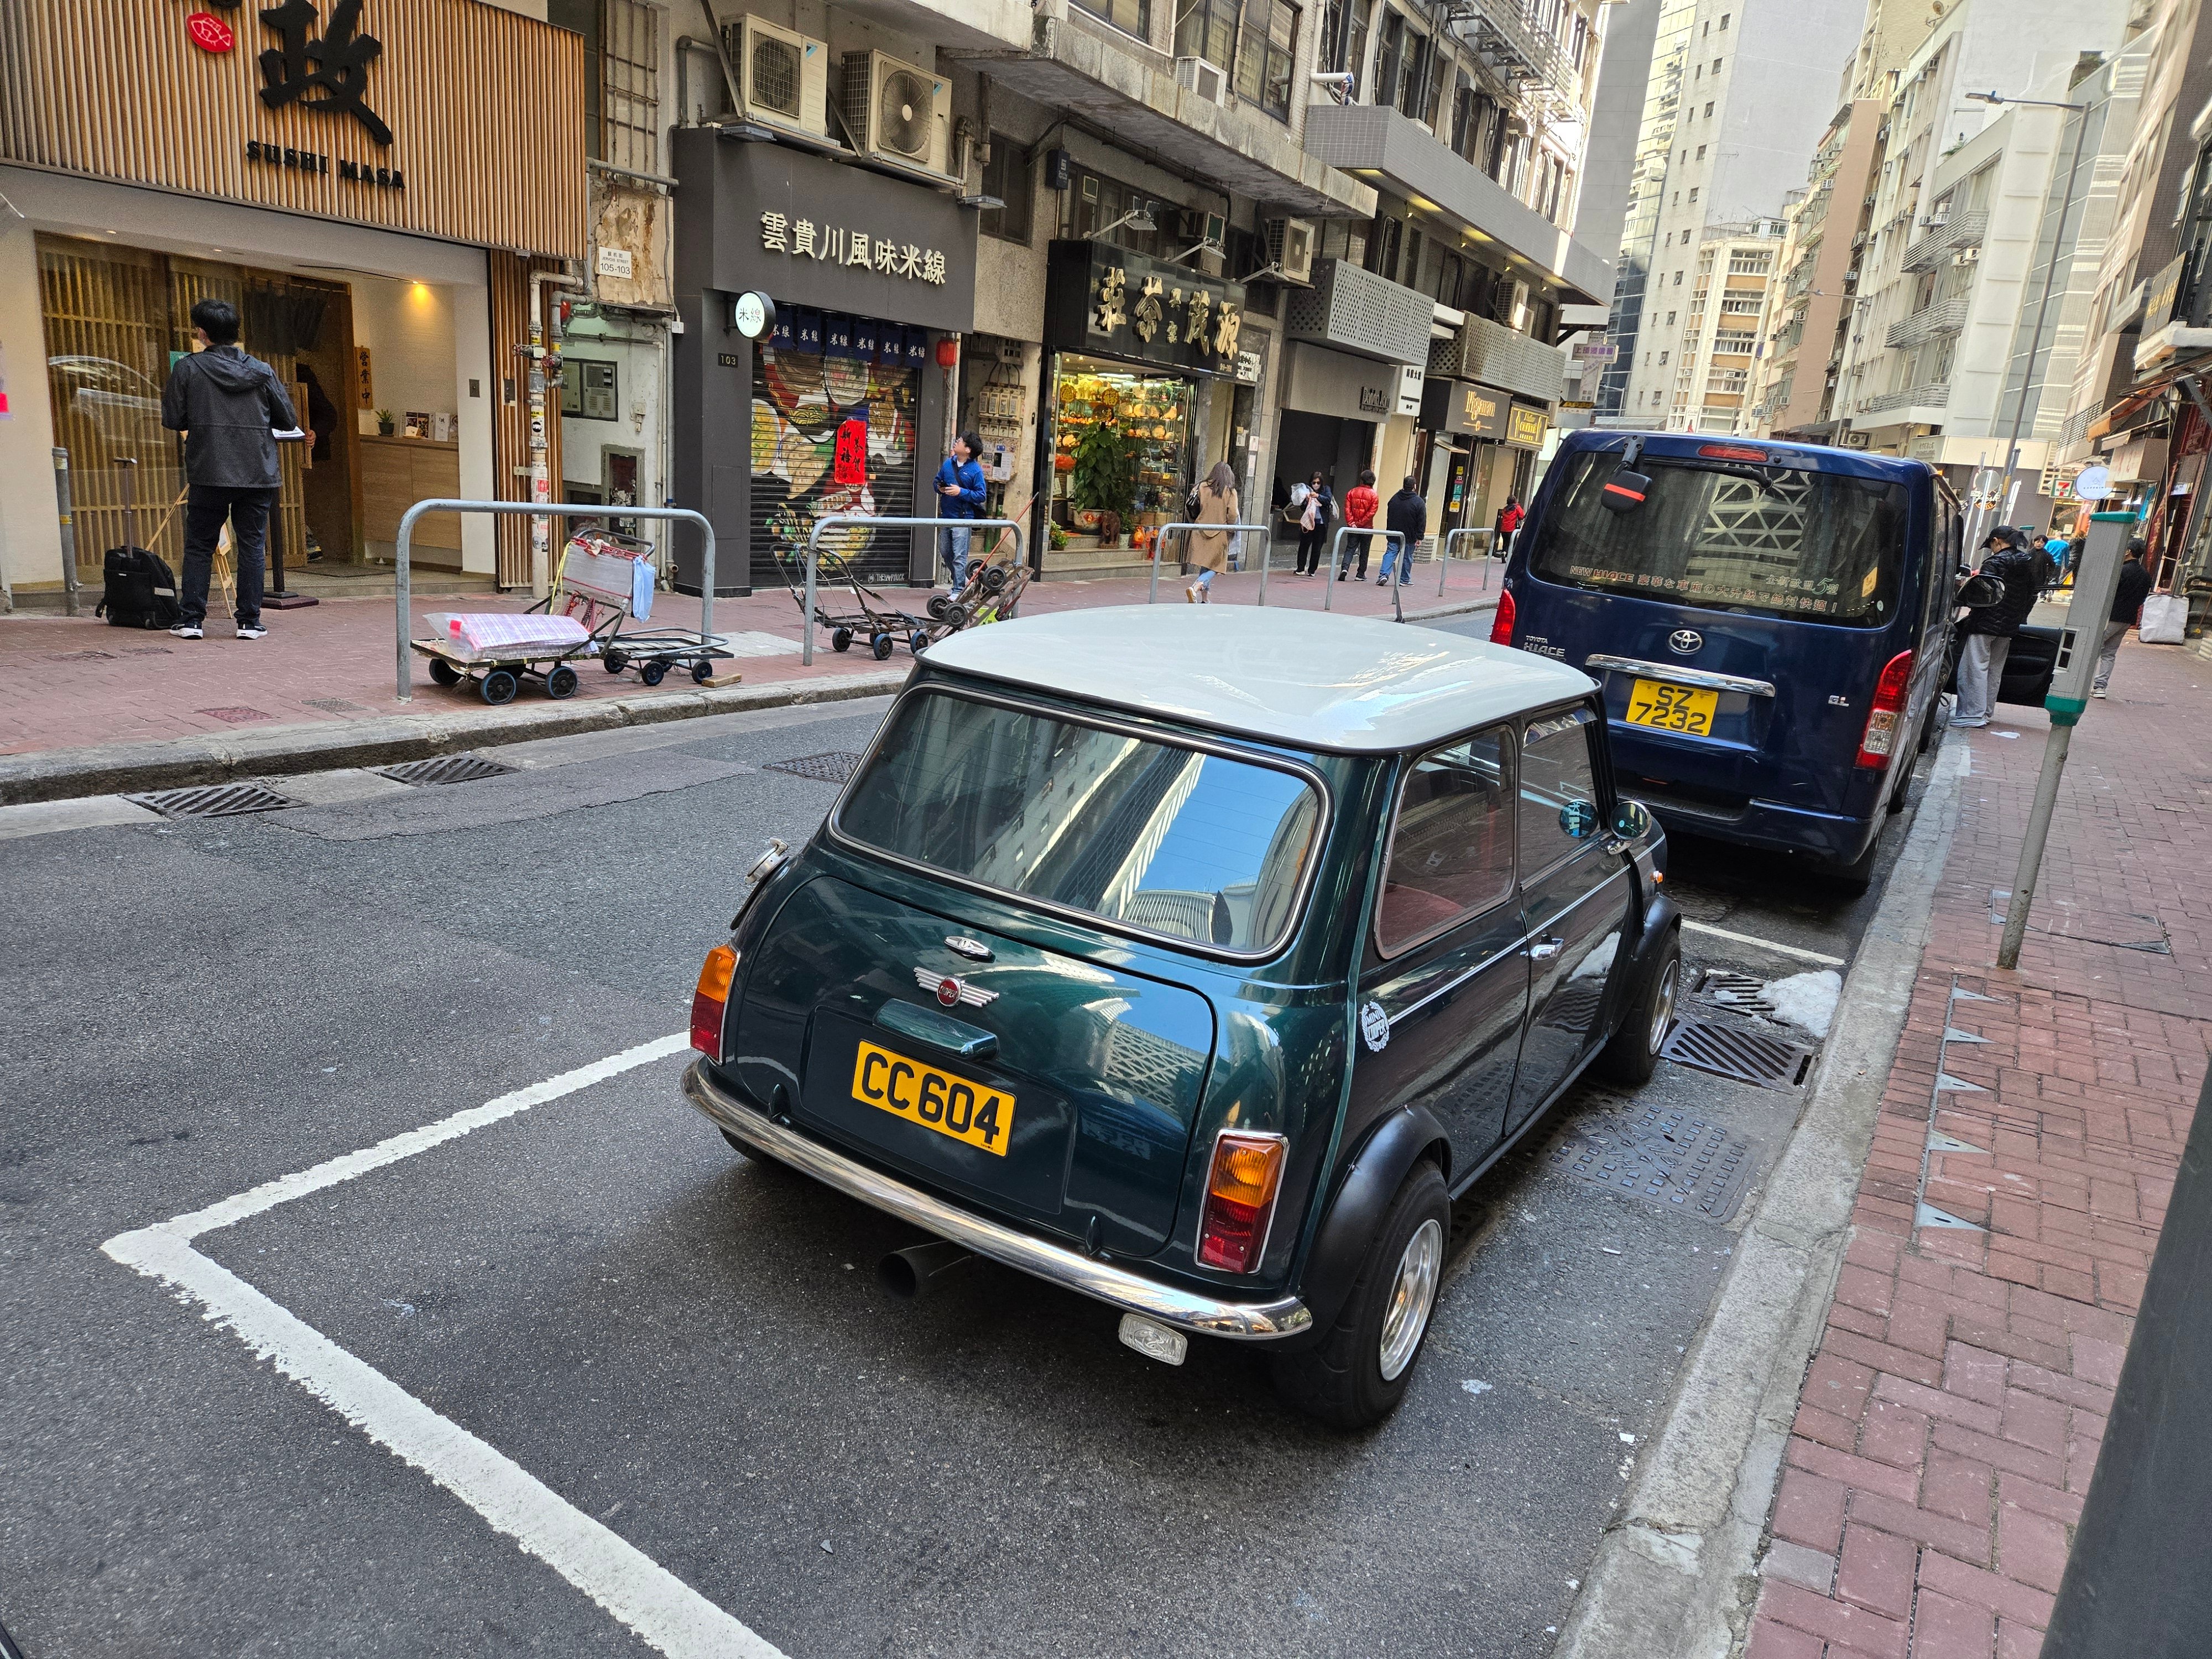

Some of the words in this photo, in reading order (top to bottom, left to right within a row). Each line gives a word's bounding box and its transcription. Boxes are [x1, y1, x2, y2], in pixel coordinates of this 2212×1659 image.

[247, 139, 329, 174] SUSHI
[340, 159, 405, 189] MASA
[760, 211, 946, 284] 雲貴川風味米線
[601, 263, 630, 274] 105-103
[739, 307, 761, 322] 米線
[800, 328, 818, 342] 米線
[830, 333, 848, 346] 米線
[857, 337, 874, 351] 米線
[884, 341, 899, 354] 米線
[909, 345, 925, 358] 米線
[721, 355, 736, 366] 103
[359, 351, 371, 404] 營業中
[1569, 565, 1593, 576] NEW
[1594, 569, 1634, 582] HIACE
[1526, 635, 1548, 644] TOYOTA
[1524, 642, 1565, 656] HIACE
[1656, 686, 1694, 711] SZ
[1828, 695, 1849, 707] GL
[1635, 702, 1707, 733] 7232
[939, 985, 957, 999] COOPER
[1365, 1010, 1381, 1025] MINI
[1368, 1018, 1386, 1041] COOPER
